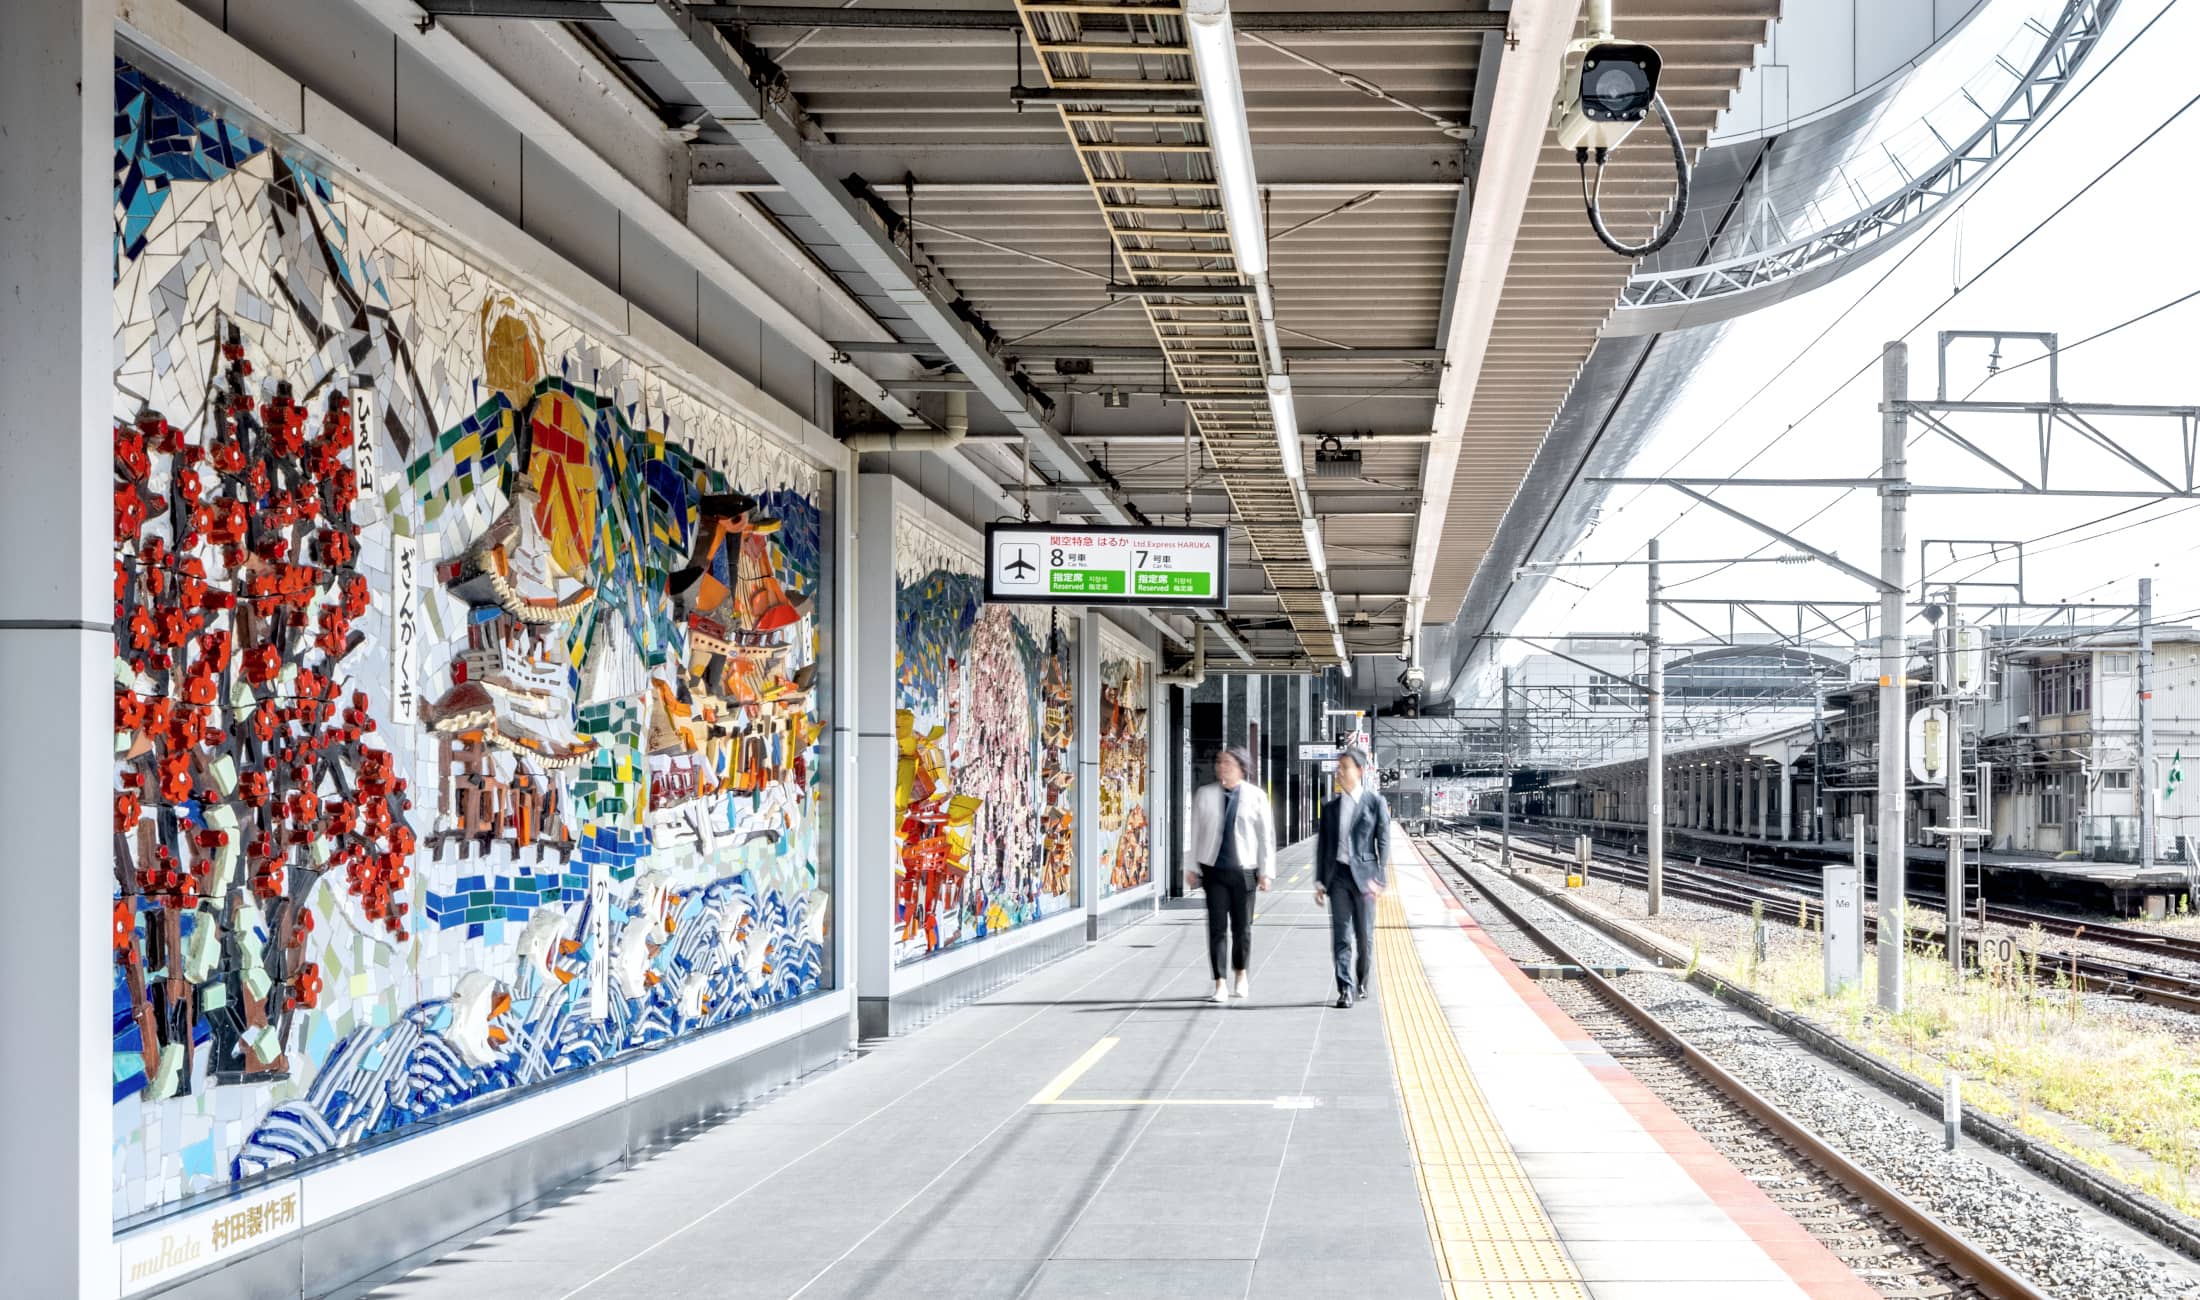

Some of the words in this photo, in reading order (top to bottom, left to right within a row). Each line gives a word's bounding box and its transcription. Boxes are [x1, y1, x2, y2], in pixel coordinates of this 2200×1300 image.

[1050, 536, 1093, 546] 関空特急
[1098, 536, 1129, 547] はるか
[1051, 549, 1064, 567] 8
[1068, 553, 1086, 562] 号車
[1136, 551, 1149, 569] 7
[1153, 555, 1171, 563] 号車
[1054, 573, 1084, 582] 指定席
[1138, 575, 1168, 584] 指定席
[1053, 582, 1084, 590] Reserved
[1138, 584, 1169, 592] Reserved
[211, 1192, 297, 1252] 村田製作所
